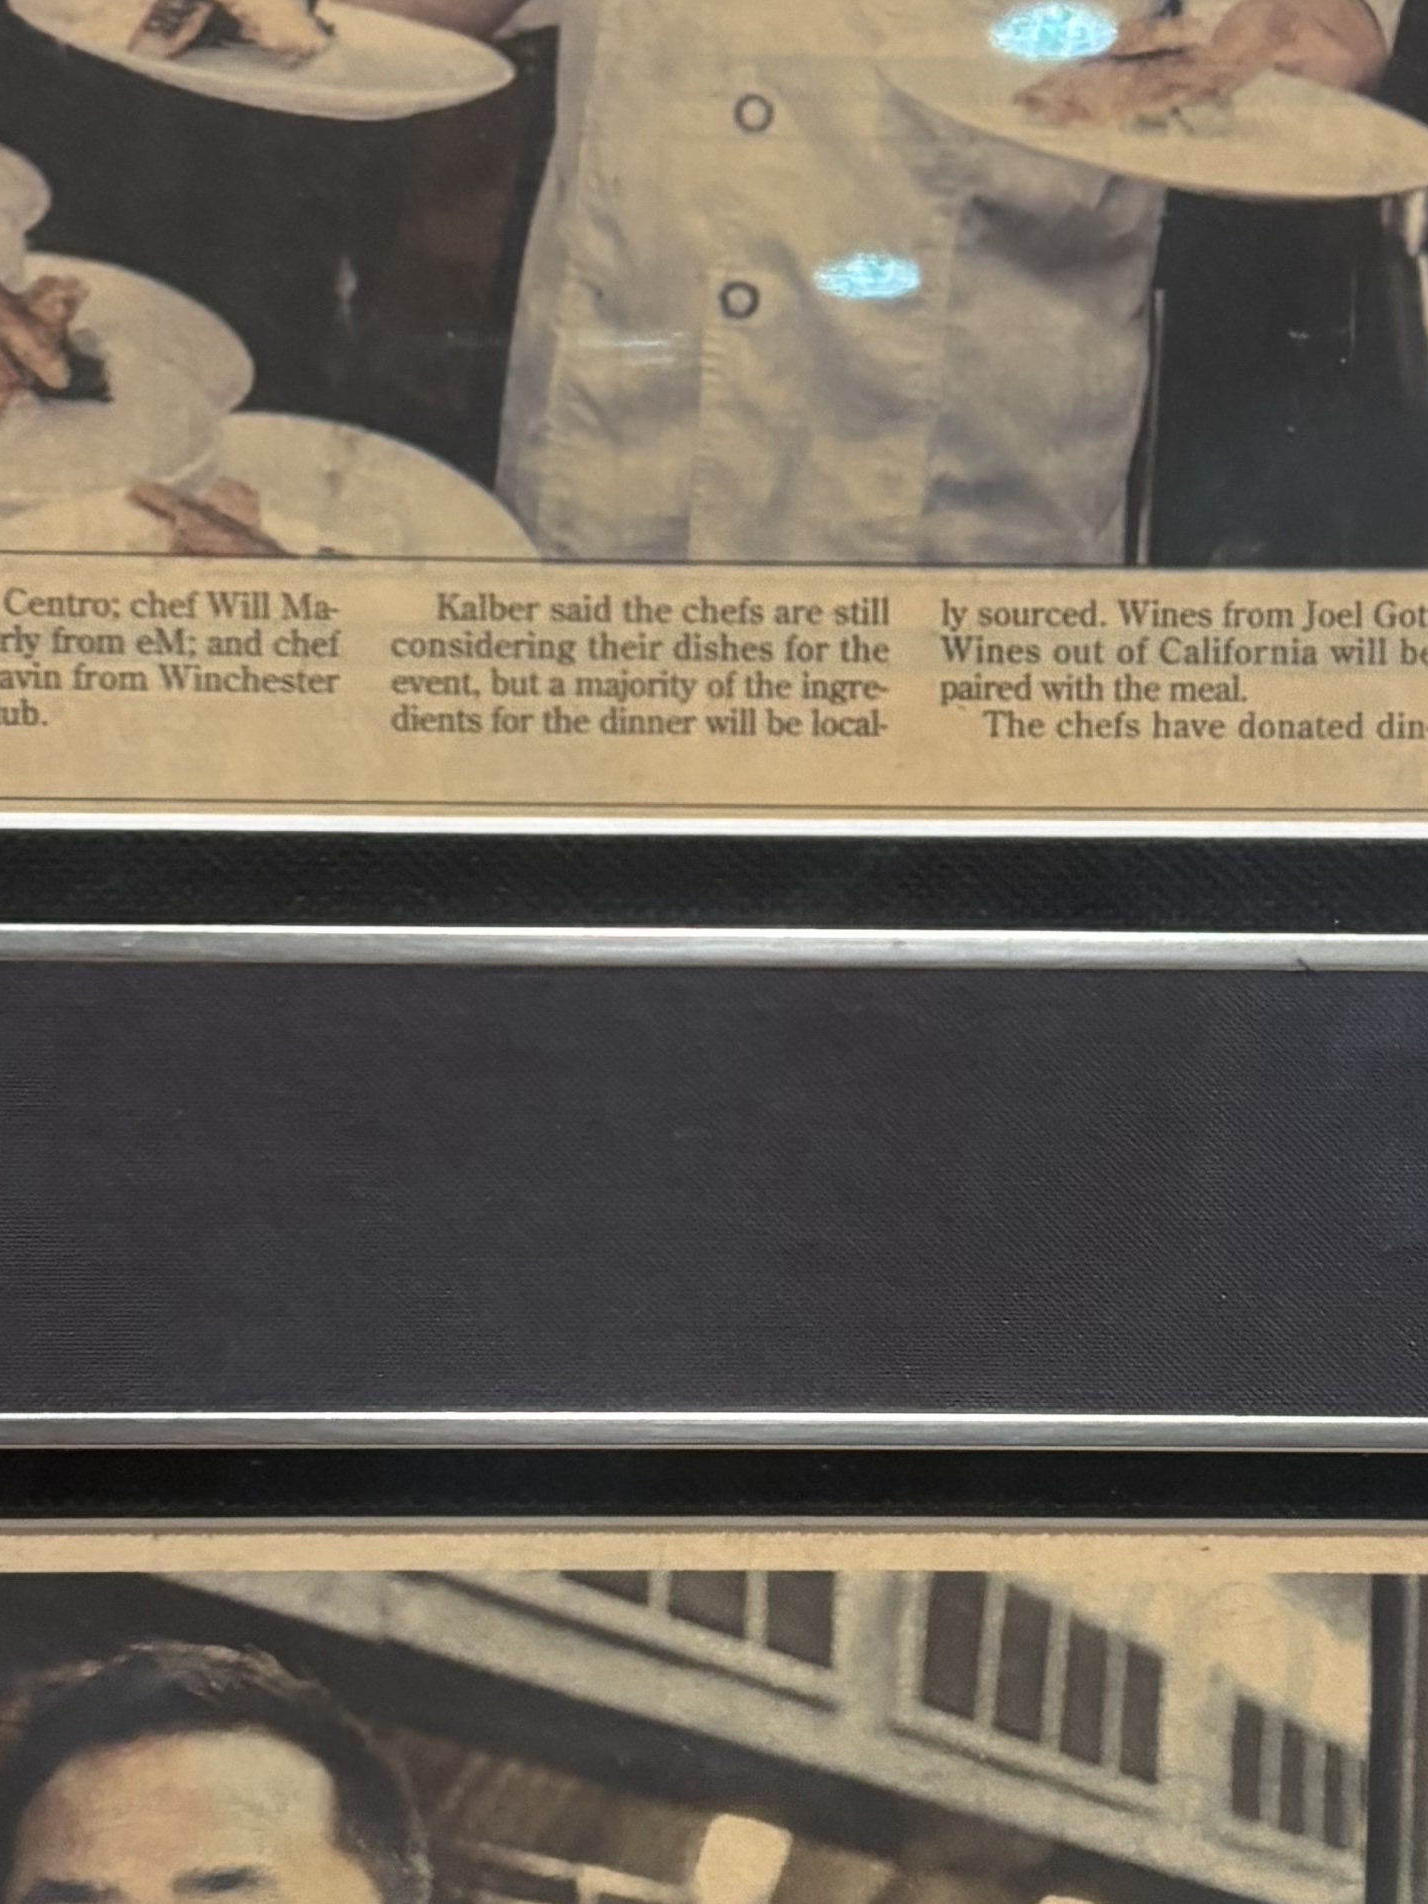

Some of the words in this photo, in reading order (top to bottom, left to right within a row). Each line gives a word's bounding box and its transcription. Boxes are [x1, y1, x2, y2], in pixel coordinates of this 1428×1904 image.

[389, 628, 578, 668] considering
[586, 629, 666, 663] their
[672, 630, 775, 664] dishes
[784, 631, 832, 664] for
[838, 632, 892, 667] the
[939, 634, 1042, 666] Wines
[1052, 638, 1106, 666] out
[1115, 634, 1151, 666] of
[1158, 635, 1319, 667] California
[1328, 635, 1388, 667] will
[71, 660, 150, 693] from
[156, 662, 342, 695] Winchester
